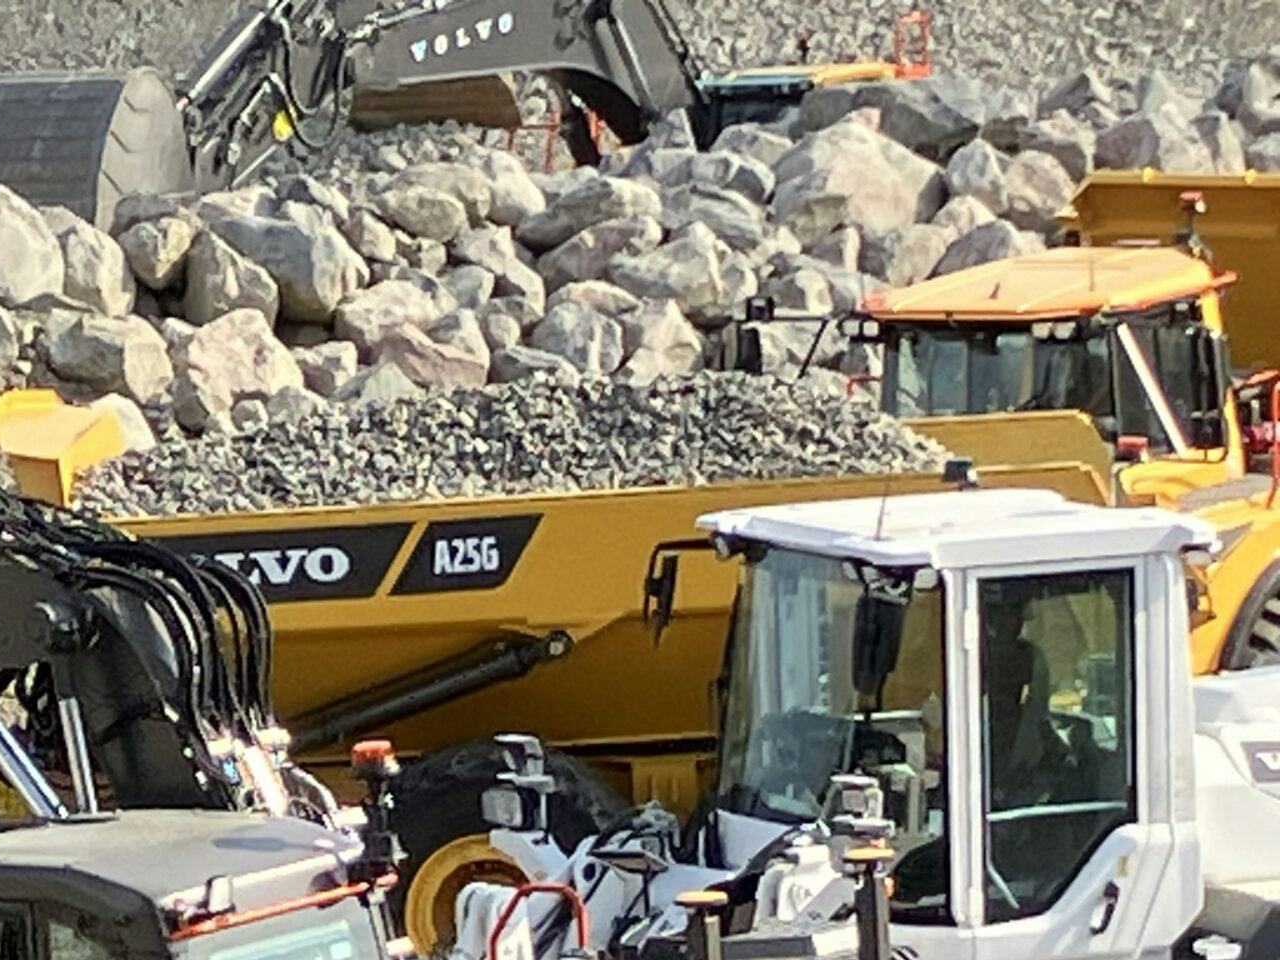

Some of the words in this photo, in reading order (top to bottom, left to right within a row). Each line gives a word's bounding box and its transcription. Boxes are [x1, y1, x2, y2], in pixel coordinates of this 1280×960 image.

[409, 11, 513, 62] VOLVO
[191, 546, 350, 585] LVO
[433, 536, 500, 575] A25G
